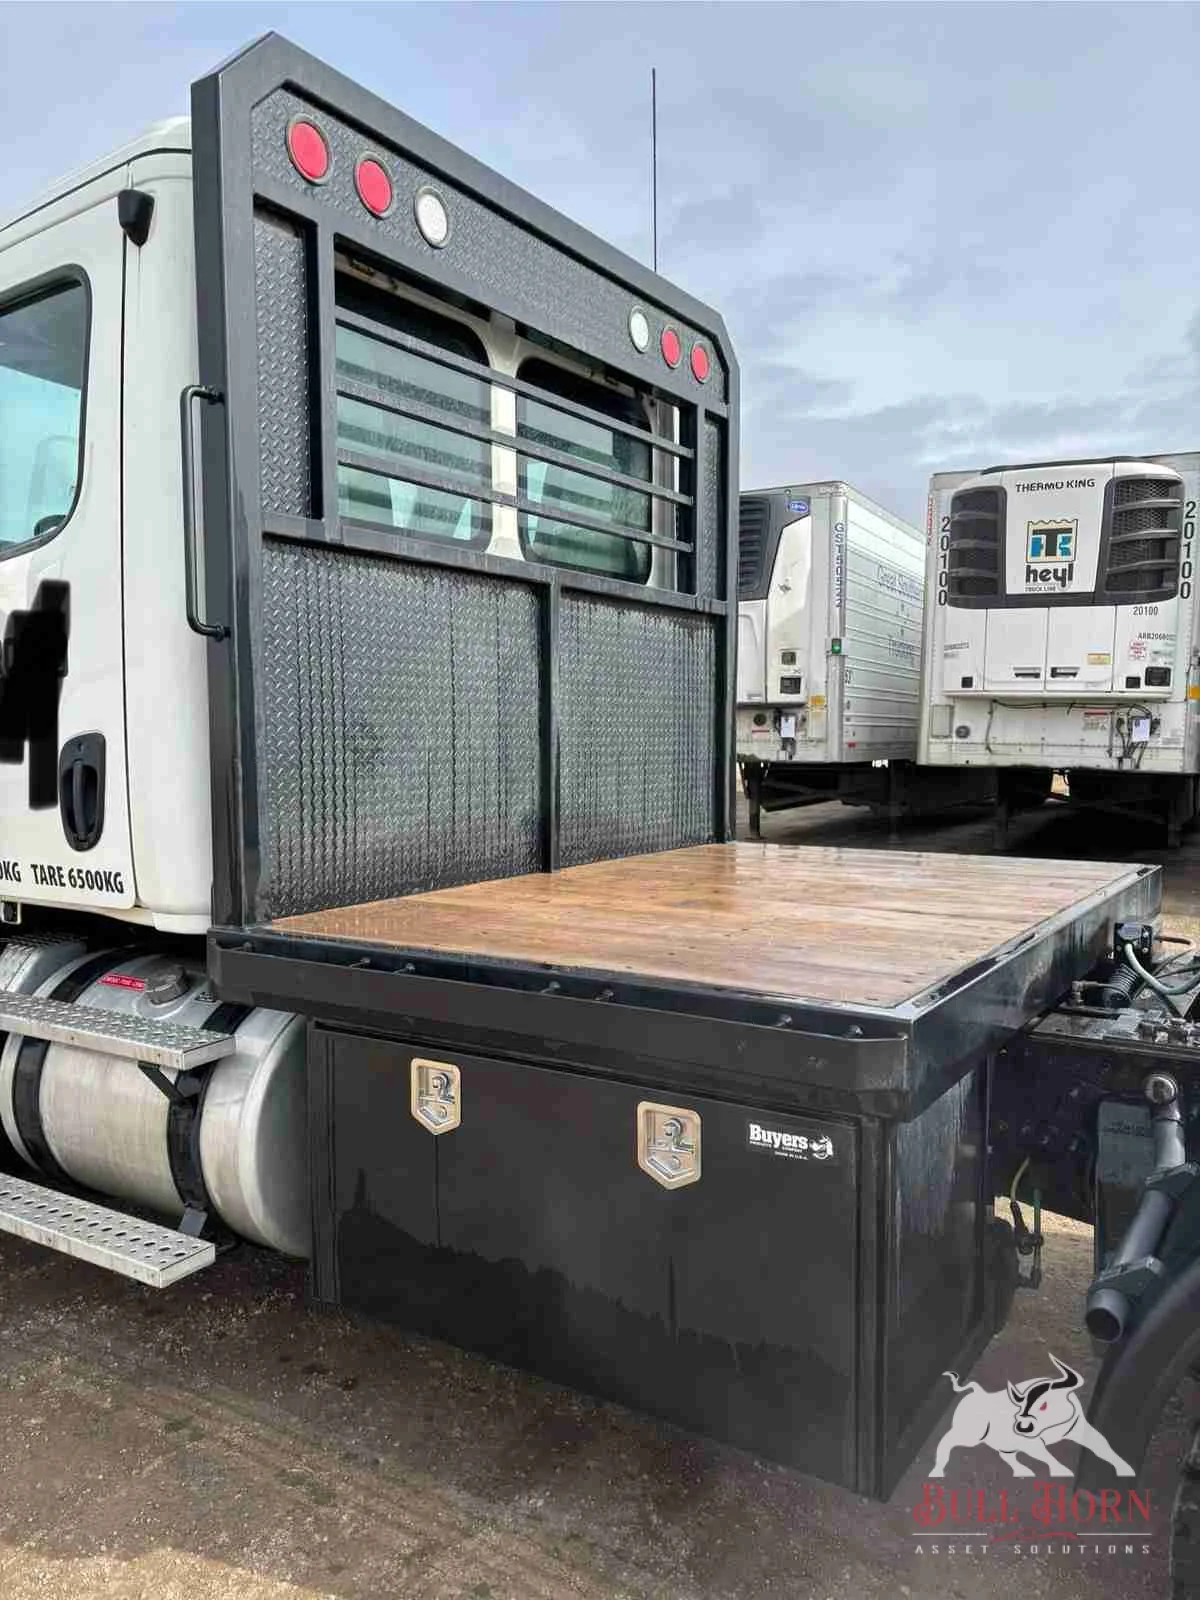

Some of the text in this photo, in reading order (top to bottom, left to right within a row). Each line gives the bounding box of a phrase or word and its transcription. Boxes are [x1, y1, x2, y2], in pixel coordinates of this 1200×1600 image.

[1016, 478, 1096, 493] THERMO KING
[938, 516, 951, 606] 20100
[1180, 500, 1196, 599] 20100
[1025, 563, 1074, 588] heyl
[1132, 605, 1159, 616] 20100
[30, 863, 66, 888] TARE
[68, 867, 125, 894] 6500KG
[749, 1123, 809, 1149] Buyers
